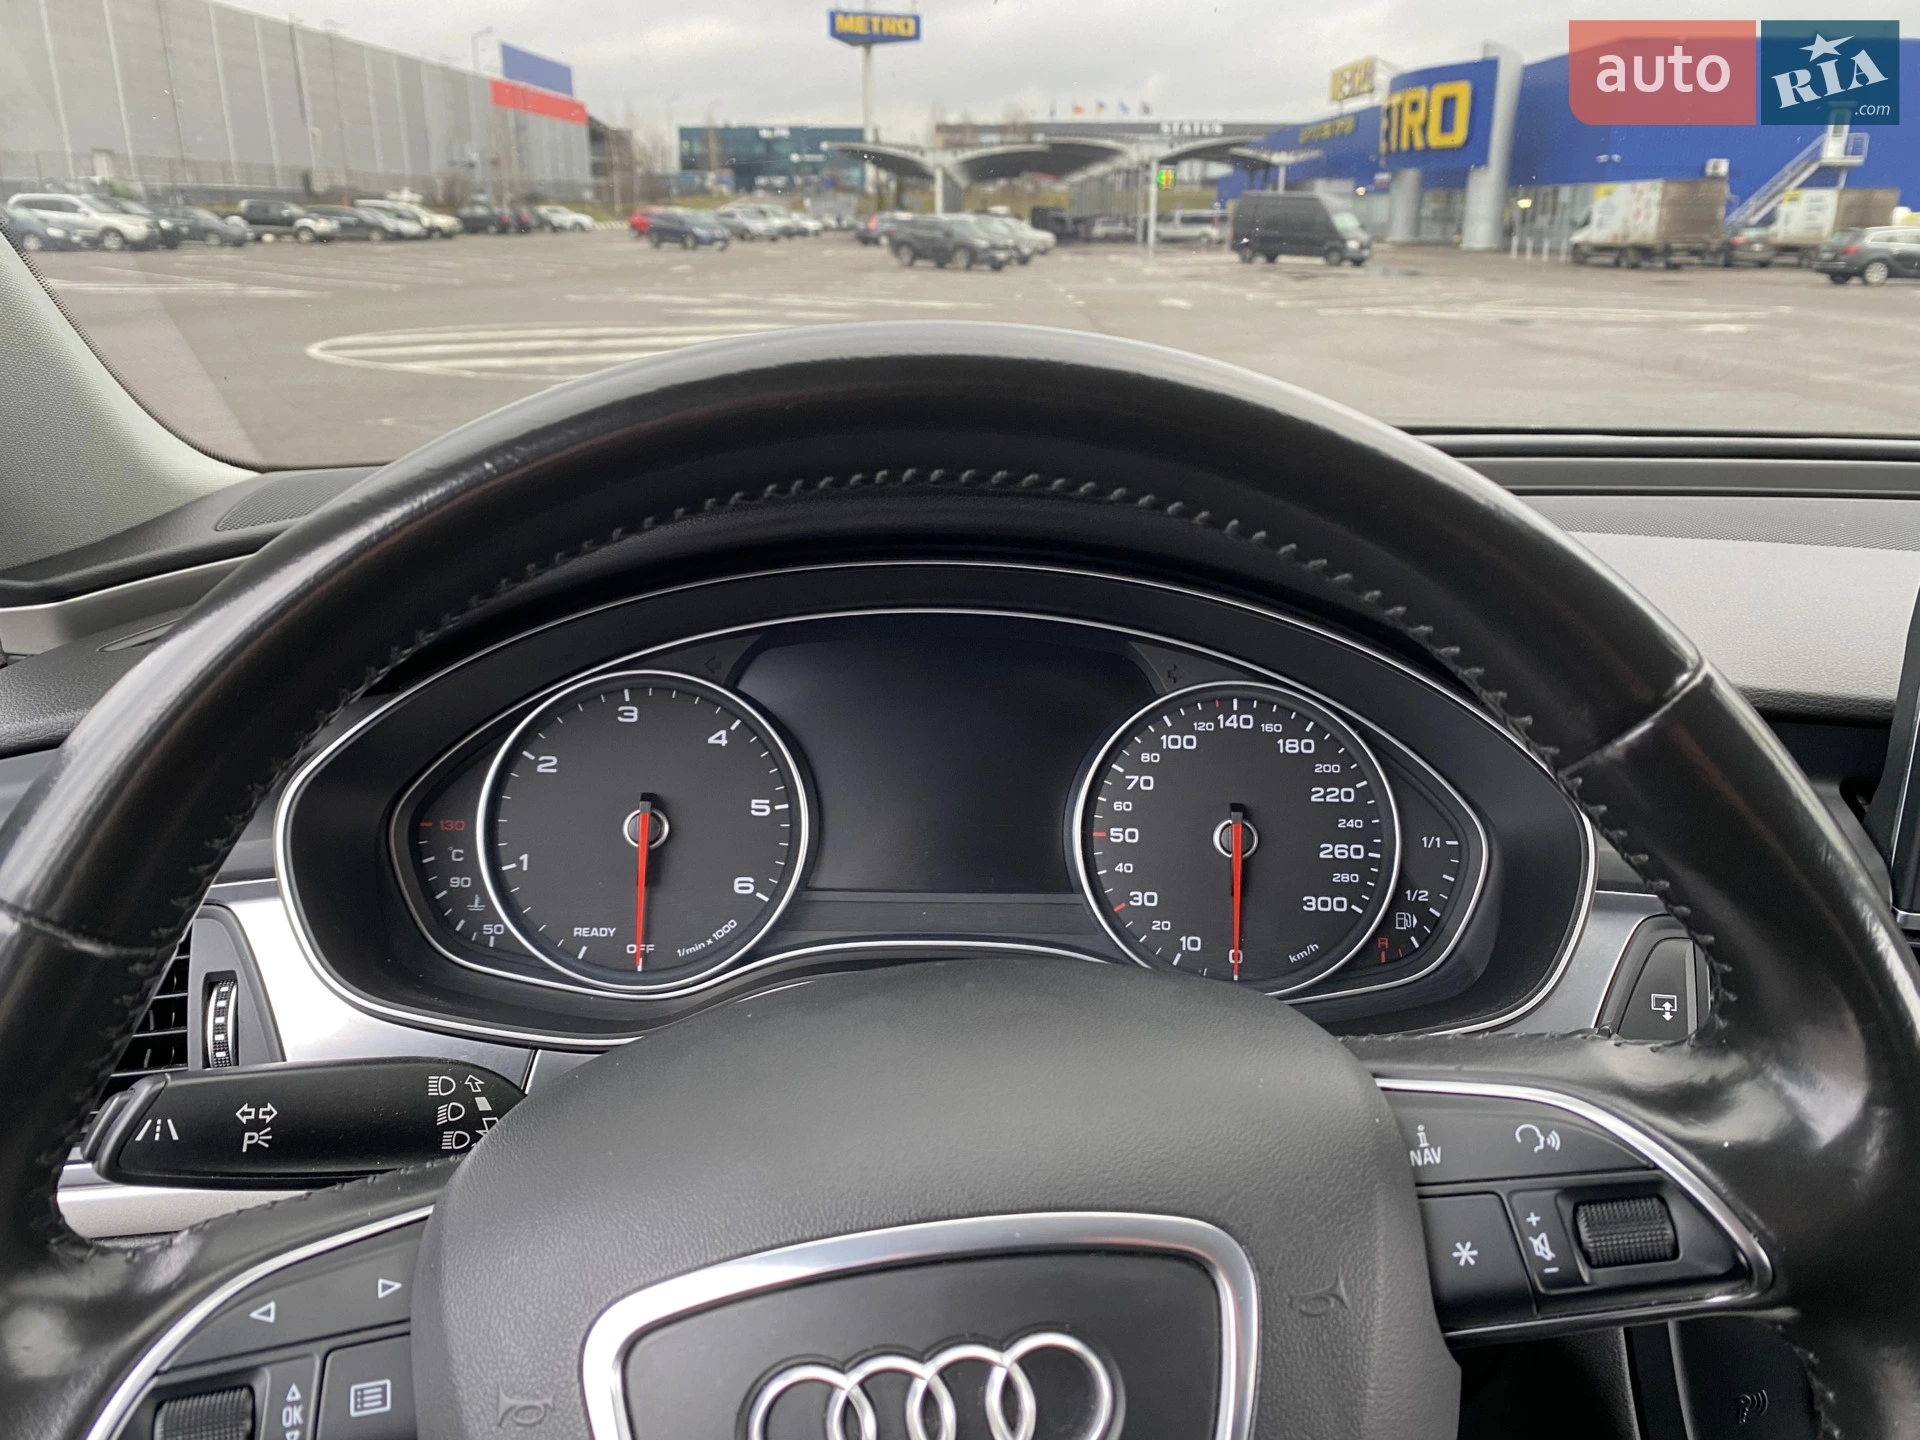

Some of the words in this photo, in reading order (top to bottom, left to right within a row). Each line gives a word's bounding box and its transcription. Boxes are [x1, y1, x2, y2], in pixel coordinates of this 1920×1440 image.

[835, 14, 916, 37] METRO
[617, 705, 639, 723] 3
[1217, 713, 1254, 730] 140
[1193, 721, 1215, 731] 120
[1260, 723, 1283, 733] 160
[707, 729, 728, 747] 4
[1160, 734, 1197, 750] 100
[1276, 738, 1315, 754] 180
[536, 755, 558, 773] 2
[1140, 752, 1160, 763] 80
[1314, 763, 1341, 774] 200
[1124, 775, 1154, 791] 70
[1310, 787, 1355, 803] 220
[750, 799, 771, 816] 5
[1113, 801, 1133, 812] 60
[440, 820, 466, 831] 130
[1337, 818, 1363, 829] 240
[1109, 827, 1139, 843] 50
[1421, 836, 1441, 849] 1/1
[1319, 843, 1364, 860] 260
[519, 853, 529, 871] 1
[1114, 862, 1134, 874] 40
[450, 876, 472, 888] 90
[734, 876, 755, 894] 6
[1332, 873, 1359, 883] 280
[1129, 891, 1158, 907] 30
[1302, 895, 1348, 912] 300
[1405, 889, 1429, 902] 1/2
[482, 924, 505, 935] 50
[573, 927, 617, 937] READY
[1151, 920, 1171, 931] 20
[676, 942, 706, 958] 1/min
[712, 919, 738, 941] 1000
[1179, 935, 1202, 951] 10
[626, 943, 655, 954] OFF
[1228, 948, 1244, 964] 0
[1288, 943, 1319, 963] km/h
[1409, 1146, 1442, 1166] NAV
[282, 1405, 303, 1428] OK
